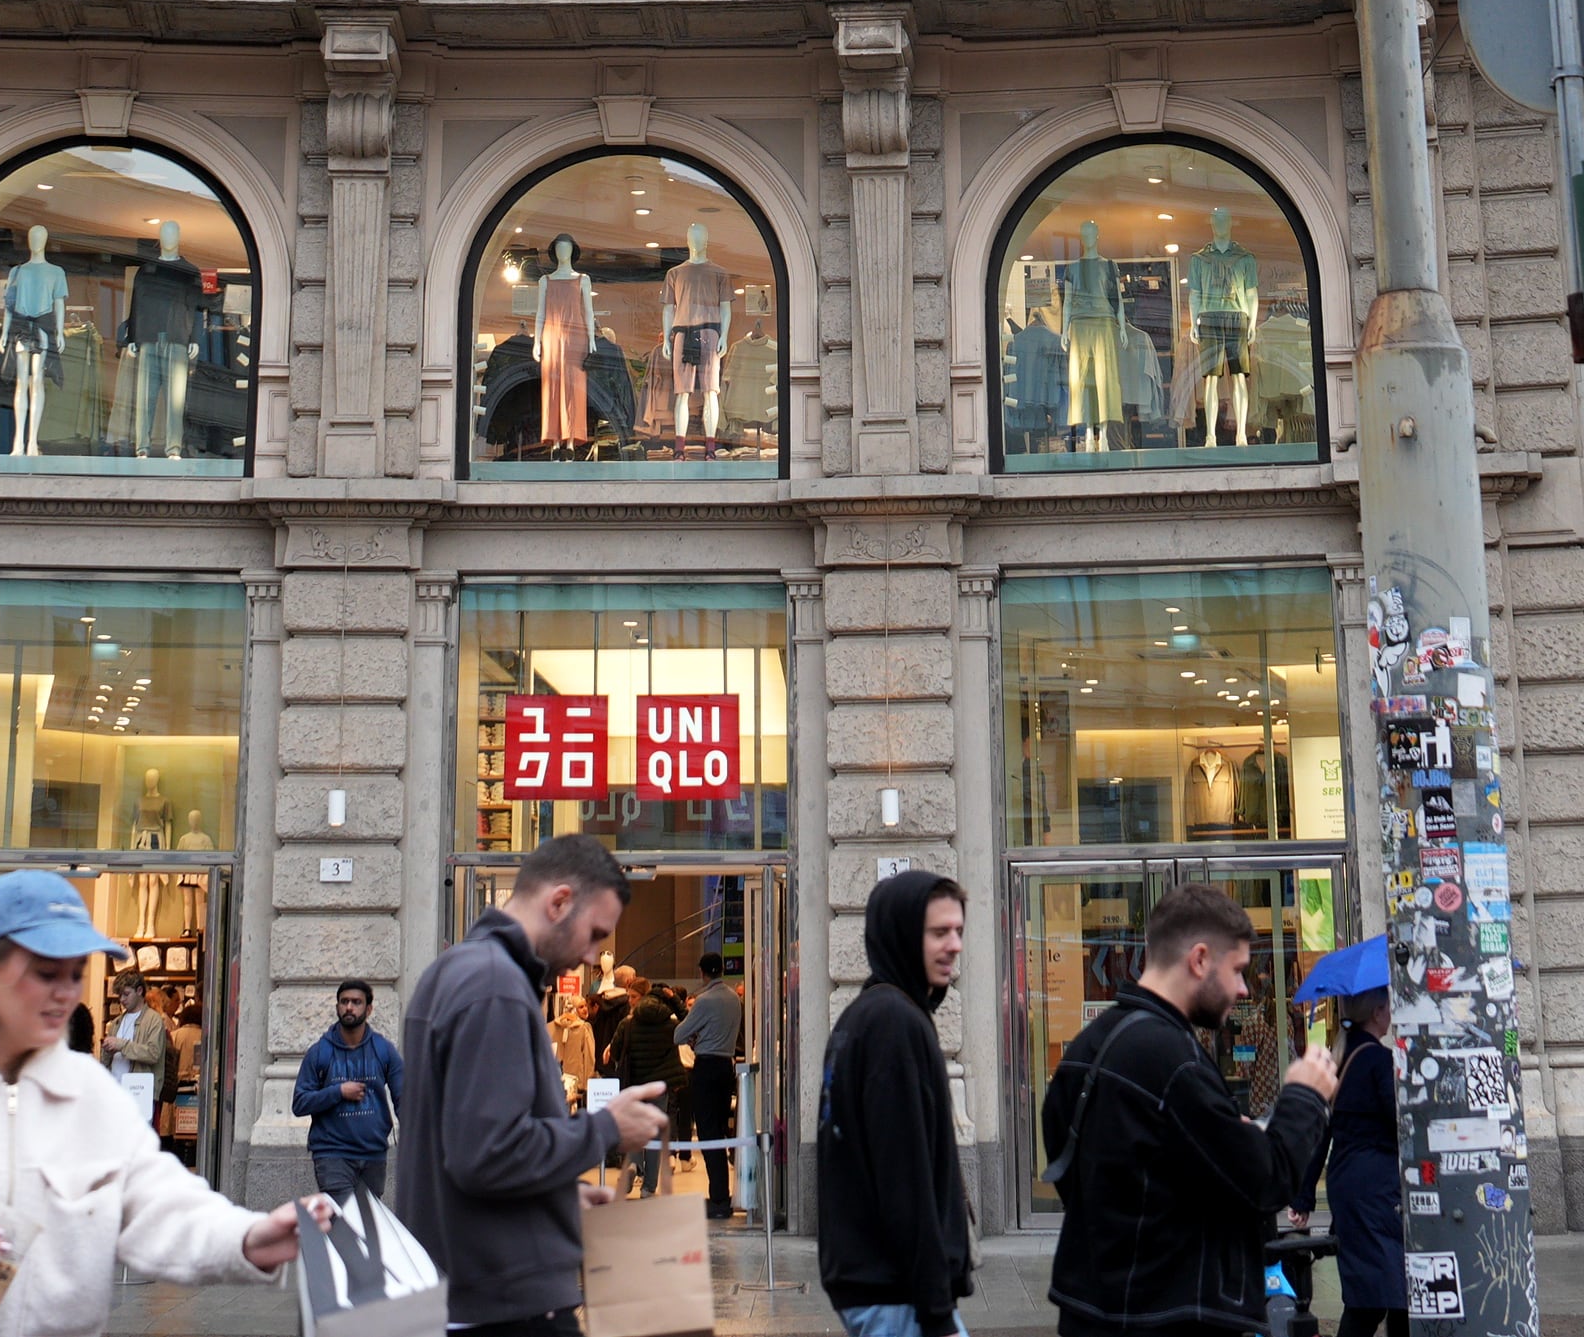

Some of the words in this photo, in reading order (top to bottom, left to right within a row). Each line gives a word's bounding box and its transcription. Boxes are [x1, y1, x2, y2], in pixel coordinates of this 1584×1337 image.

[519, 707, 594, 743] ユニ
[648, 706, 720, 743] UNI
[514, 751, 594, 787] クロ
[648, 750, 729, 793] QLO
[332, 862, 340, 876] 3
